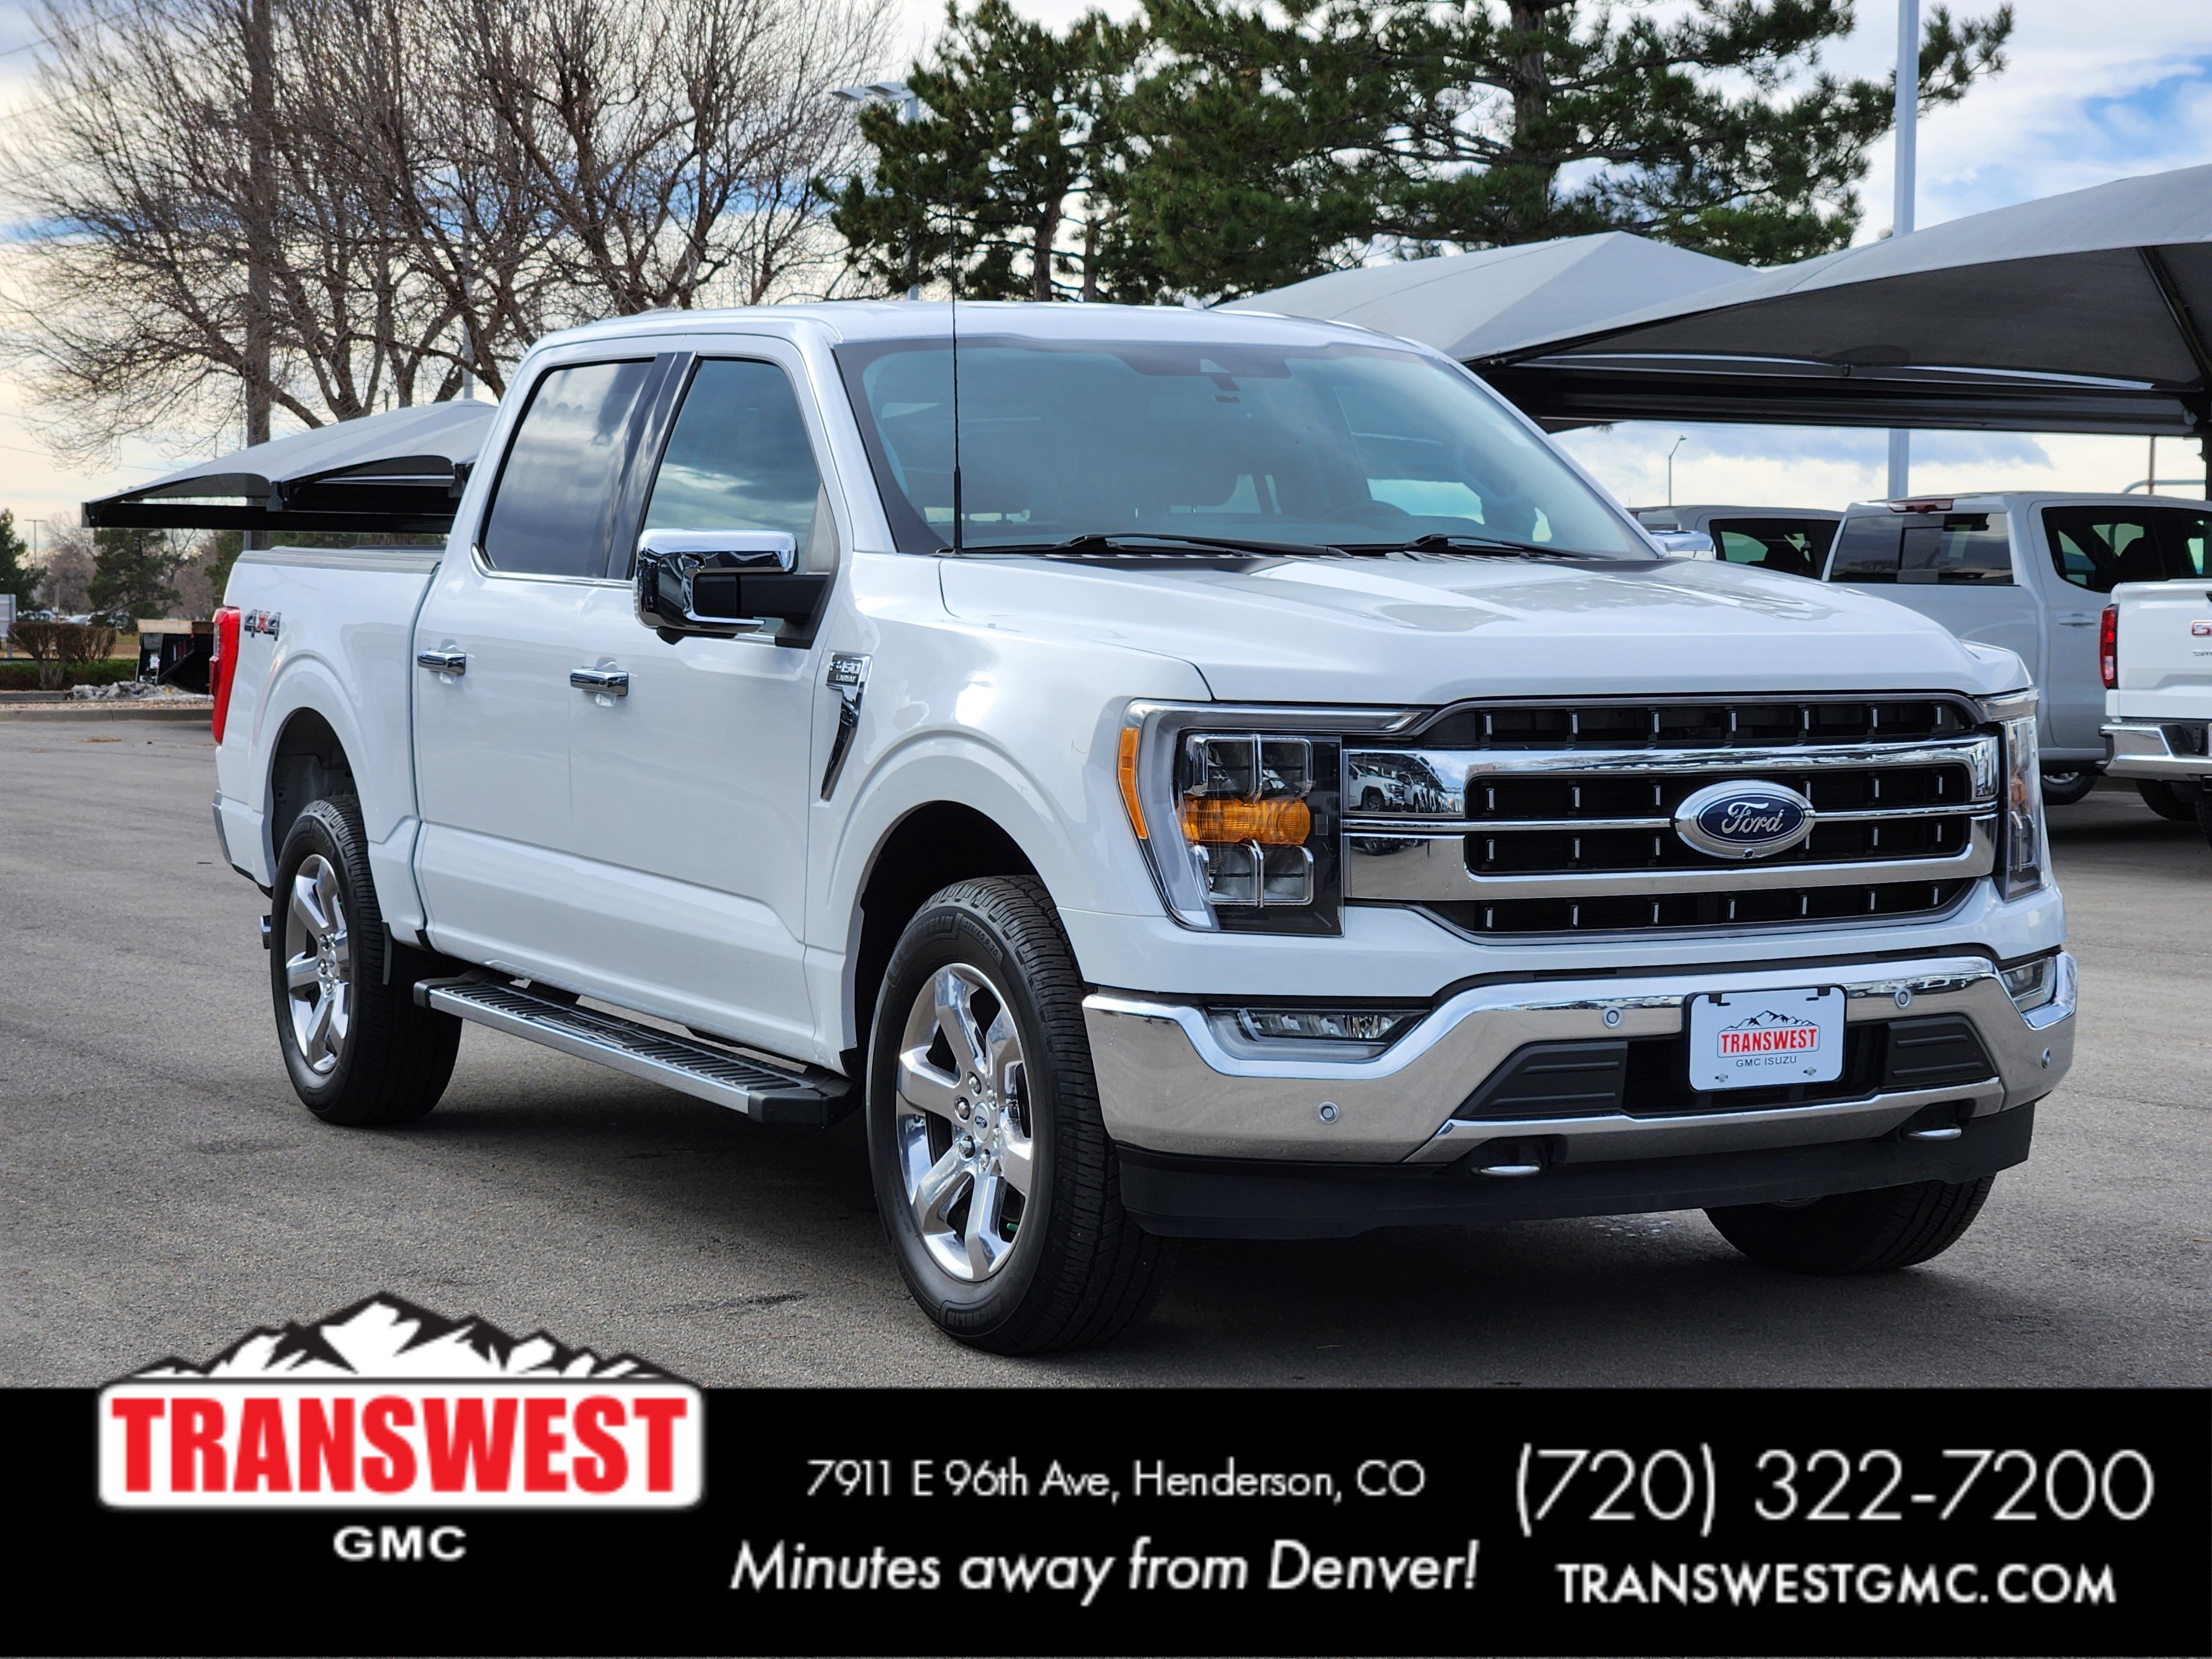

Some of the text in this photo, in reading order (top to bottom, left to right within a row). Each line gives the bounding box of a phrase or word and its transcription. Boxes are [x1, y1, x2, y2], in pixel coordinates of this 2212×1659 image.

[836, 674, 857, 683] LARIAT
[1721, 802, 1785, 834] Ford
[963, 921, 985, 940] 275/60
[989, 946, 999, 956] 20
[1721, 1029, 1817, 1053] TRANSWEST
[1736, 1056, 1797, 1067] GMC ISUZU
